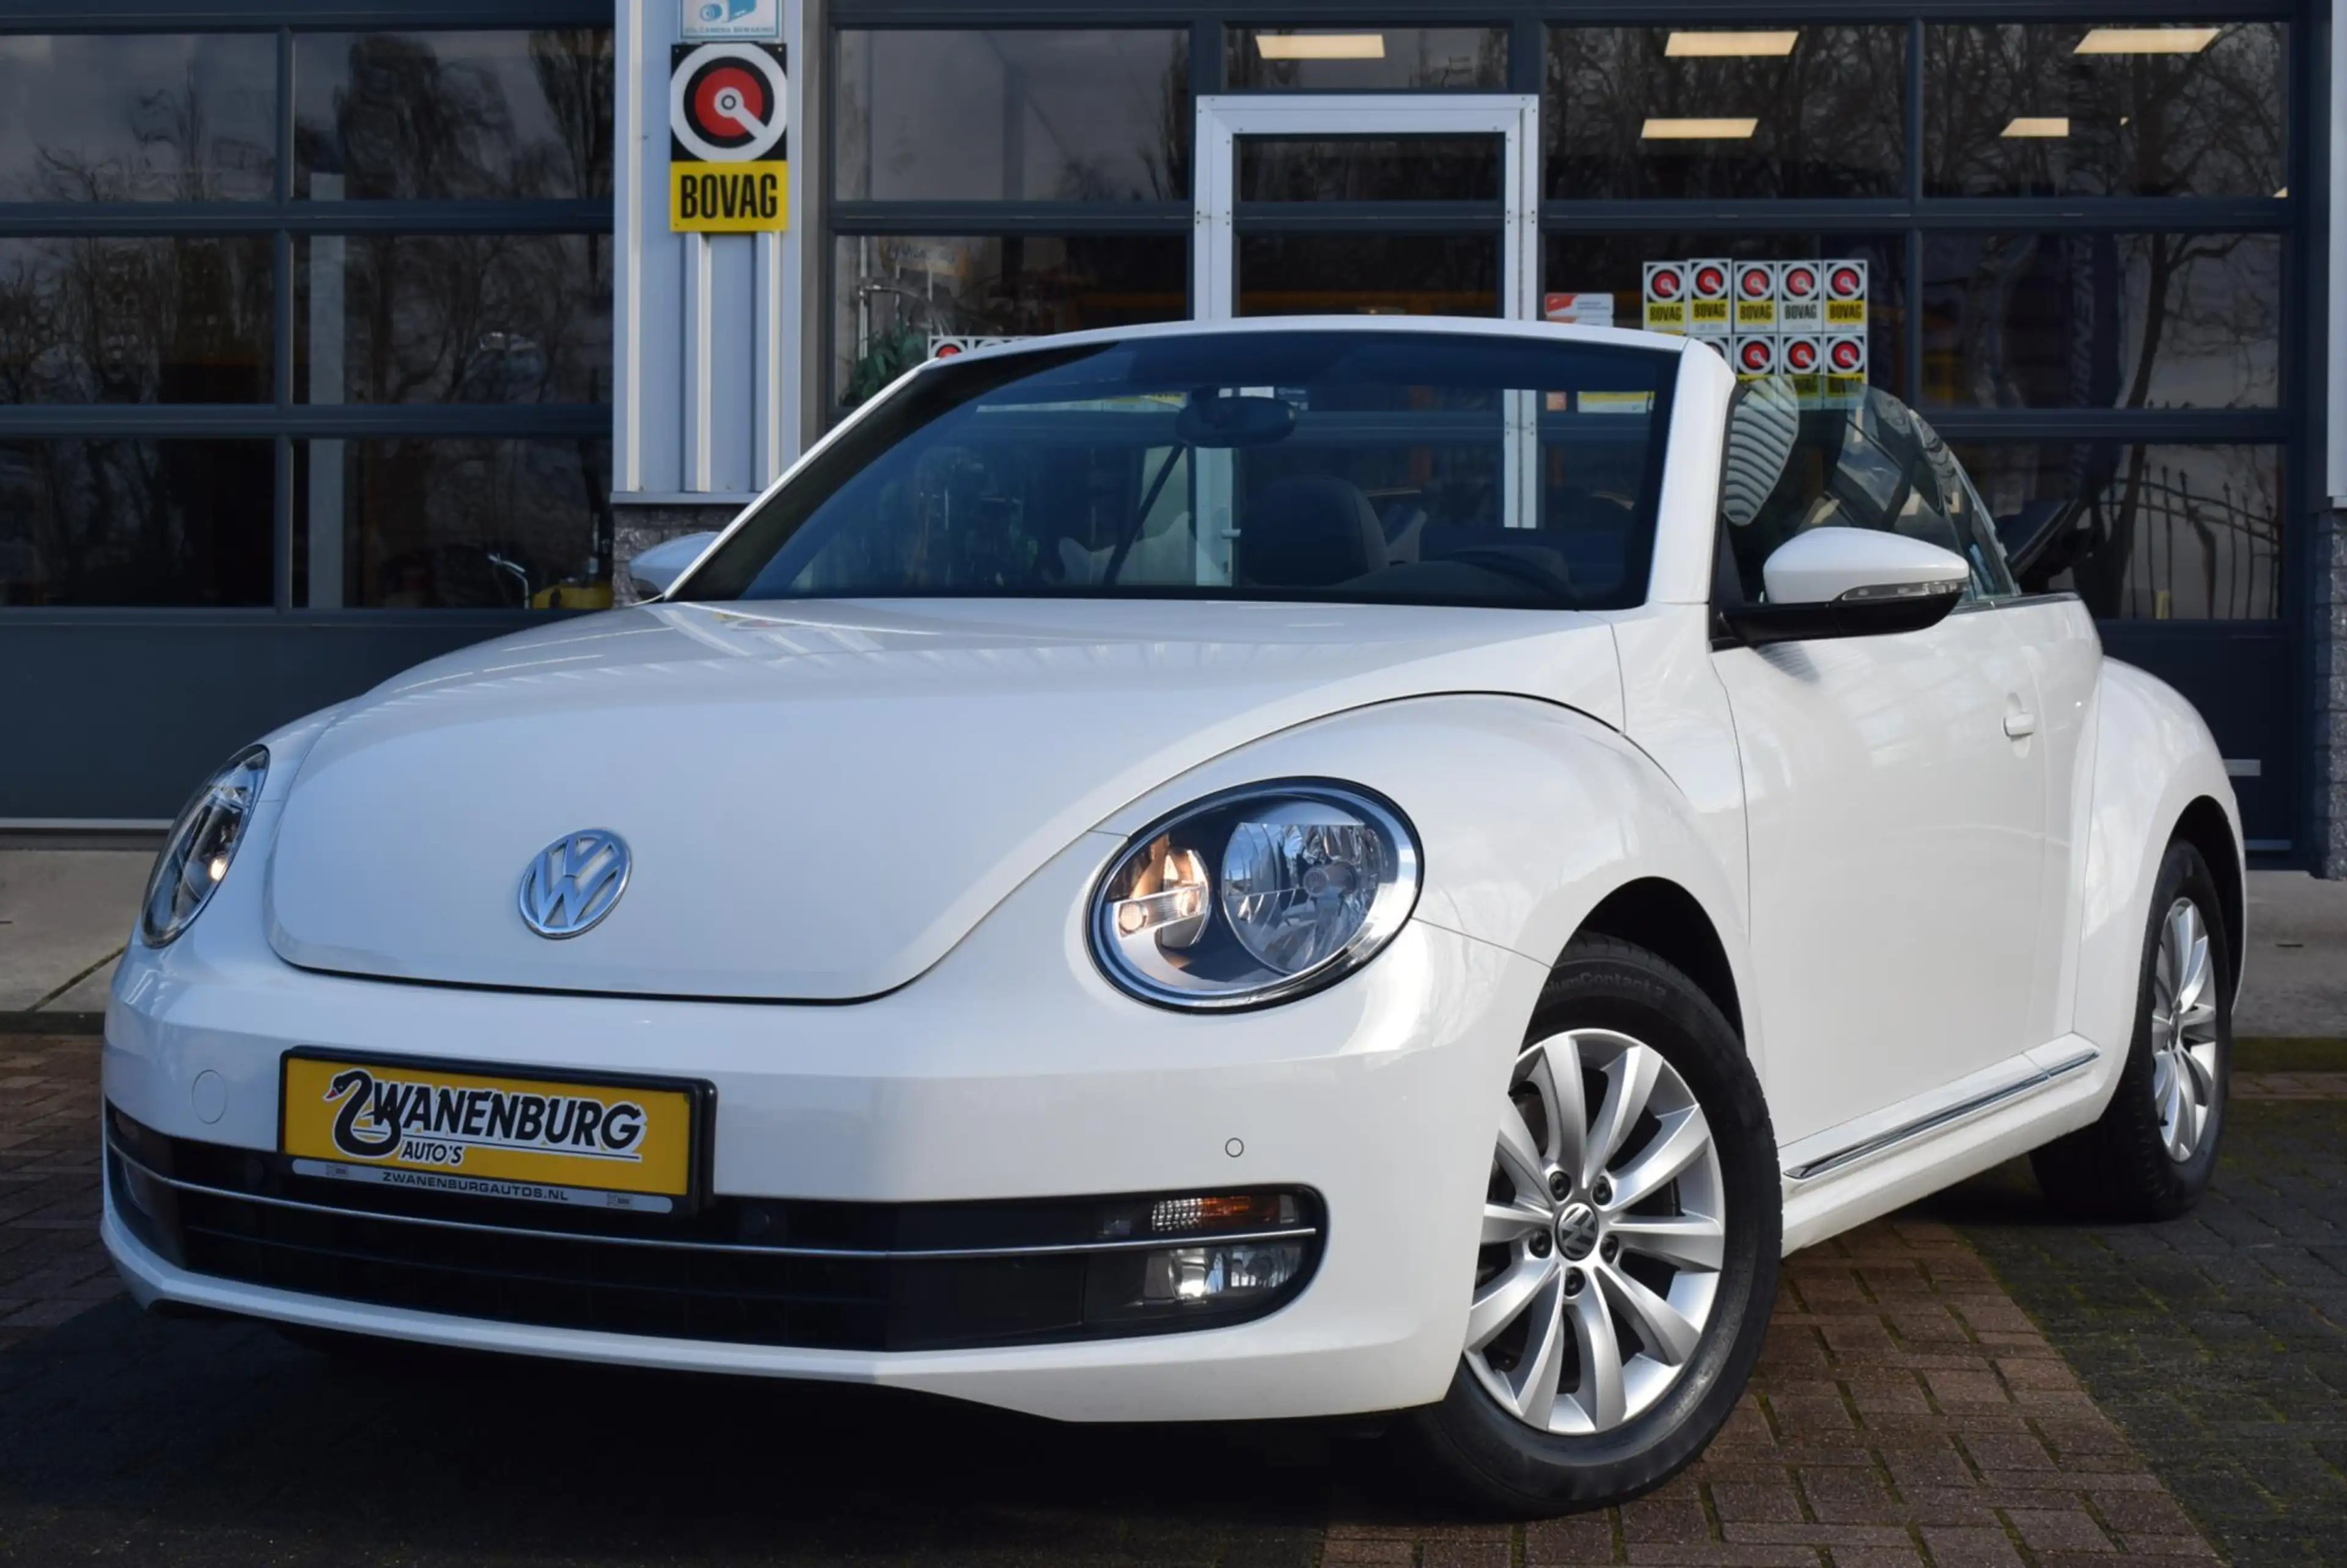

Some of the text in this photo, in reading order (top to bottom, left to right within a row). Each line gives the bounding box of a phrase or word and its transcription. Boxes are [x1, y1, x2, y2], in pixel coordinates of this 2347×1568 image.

[680, 174, 778, 219] BOVAG
[1650, 306, 1682, 321] BOVAG
[1694, 303, 1726, 318] BOVAG
[1739, 306, 1772, 320] BOVAG
[1784, 304, 1817, 320] BOVAG
[1829, 304, 1862, 320] BOVAG
[402, 1141, 463, 1164] AUTO'S
[382, 1171, 569, 1201] ZWANENBURGAUTOS.NL
